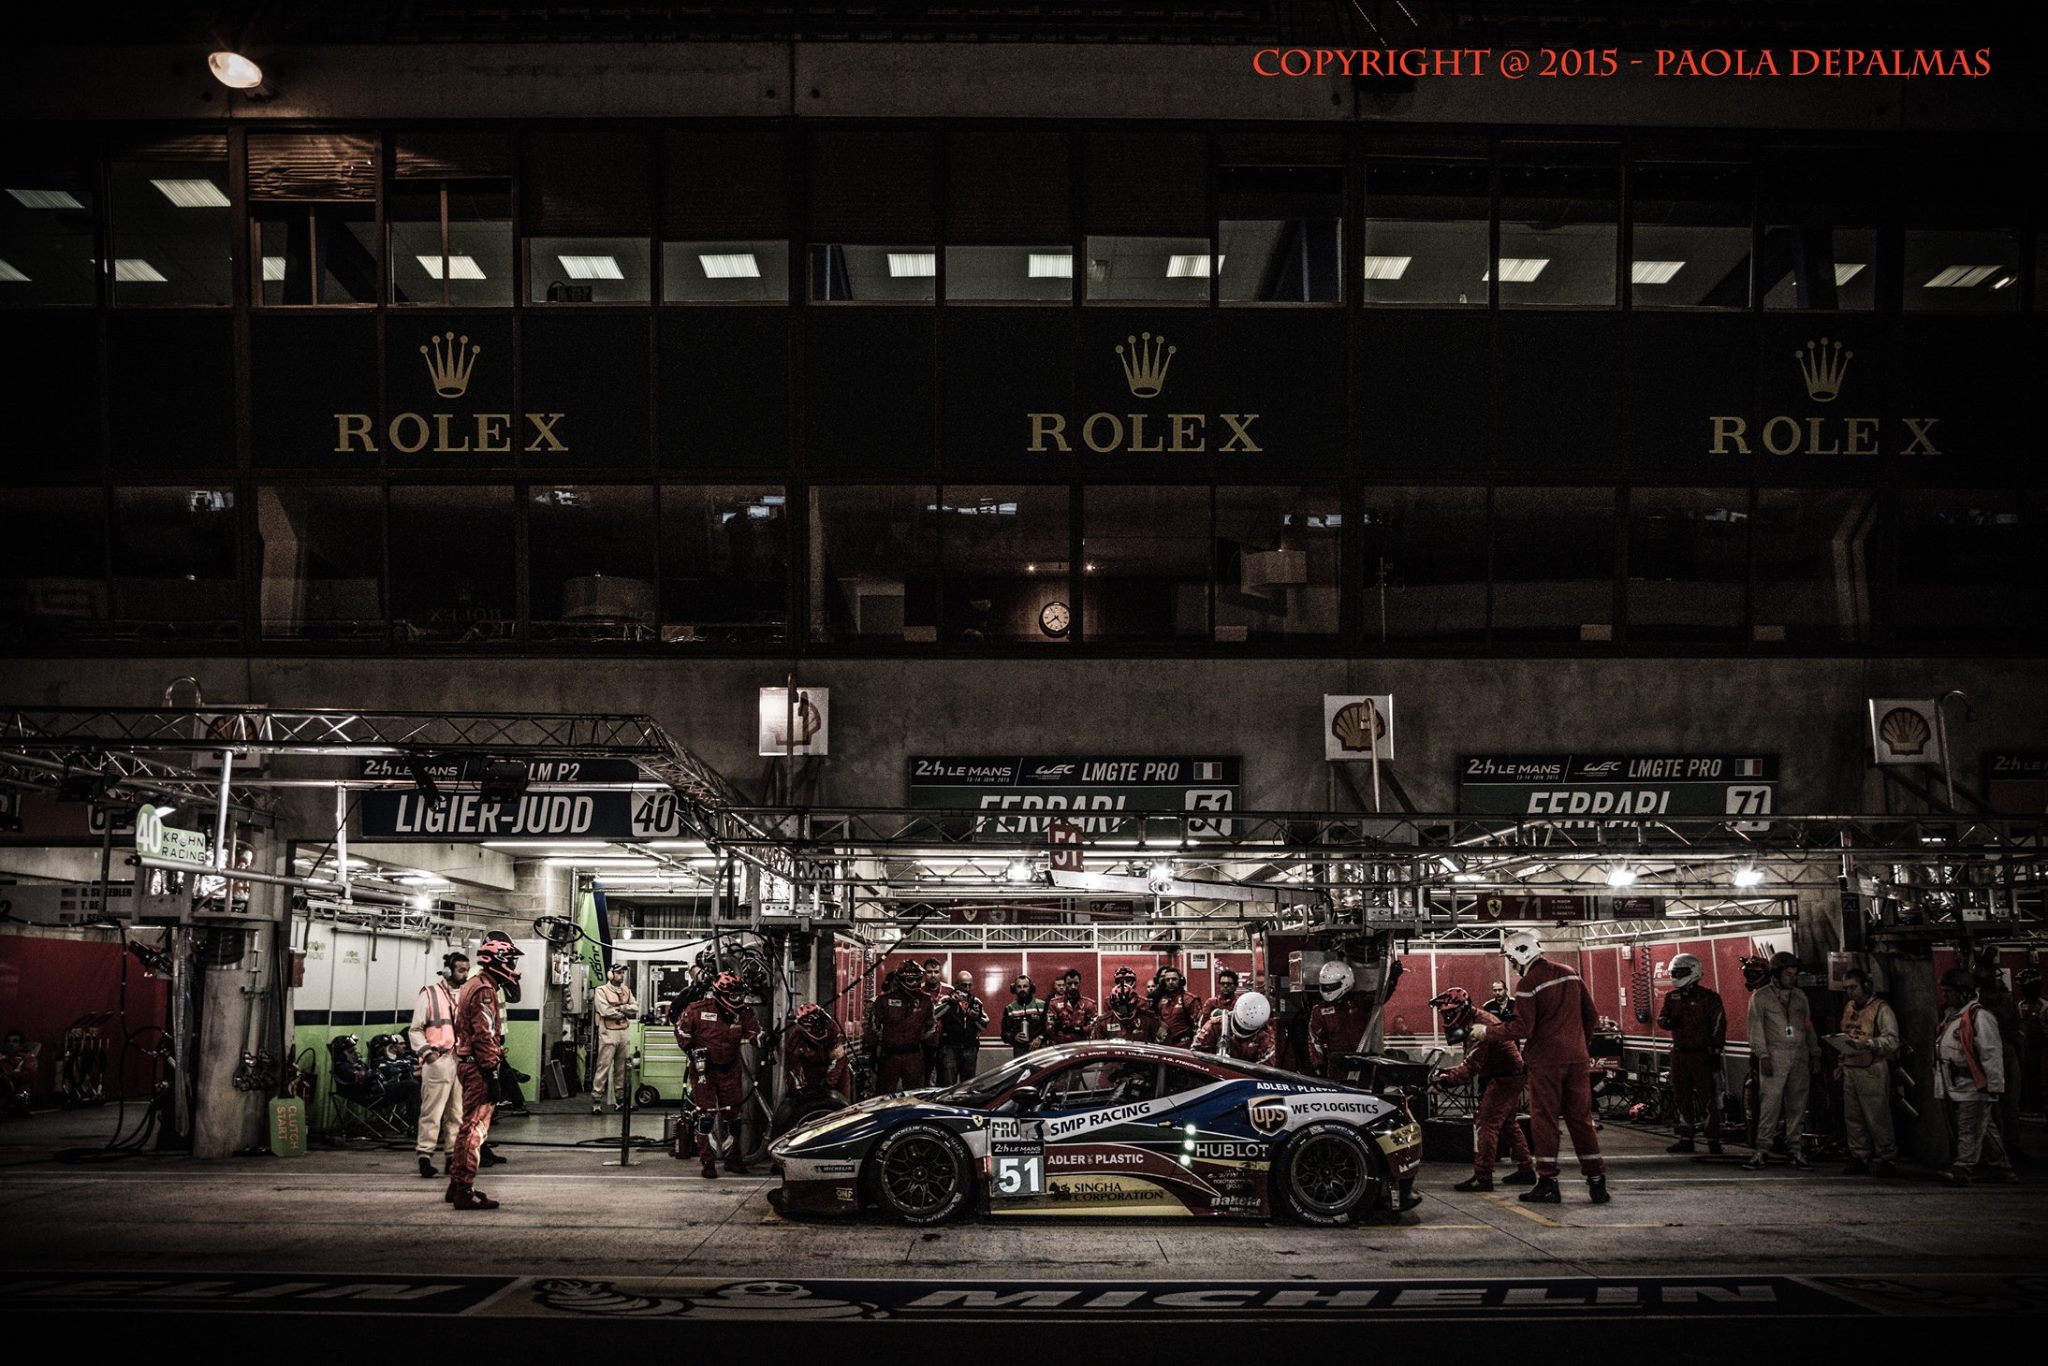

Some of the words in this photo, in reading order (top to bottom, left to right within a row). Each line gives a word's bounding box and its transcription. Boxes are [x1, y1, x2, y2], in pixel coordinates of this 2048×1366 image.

[333, 411, 570, 454] ROLEX
[1026, 411, 1264, 454] ROLEX
[1708, 415, 1943, 456] ROLEX
[418, 766, 459, 777] ANS
[527, 762, 552, 781] LM
[556, 762, 580, 782] P2
[946, 766, 967, 777] LE
[969, 766, 1012, 777] MANS
[1081, 762, 1137, 782] LMGTE
[1142, 762, 1180, 781] PRO
[1498, 764, 1516, 774] LE
[1518, 764, 1561, 774] MANS
[1627, 759, 1684, 778] LMGTE
[1687, 759, 1722, 777] PRO
[394, 795, 594, 834] LIGIER-JUDD
[633, 794, 678, 833] 40
[975, 795, 1127, 833] FERRARI
[1189, 794, 1229, 833] 51
[1727, 790, 1767, 827] 71
[137, 812, 162, 855] 40
[161, 846, 206, 863] RACING
[1055, 831, 1078, 867] 51
[1514, 896, 1543, 920] 71
[1256, 1082, 1291, 1092] ADLER
[1050, 1116, 1086, 1136] SMP
[1089, 1102, 1151, 1127] RACING
[1253, 1107, 1286, 1129] ups
[1291, 1103, 1310, 1114] WE
[1324, 1102, 1379, 1115] LOGISTICS
[991, 1120, 1020, 1139] PRO
[1047, 1155, 1086, 1165] ADLER
[1095, 1153, 1144, 1165] PLASTIC
[1195, 1143, 1270, 1158] HUBLOT
[998, 1157, 1041, 1193] 51
[1073, 1190, 1164, 1201] CORPORATION
[1074, 1182, 1122, 1193] SINGHA
[904, 1285, 1778, 1308] MICHELIN
